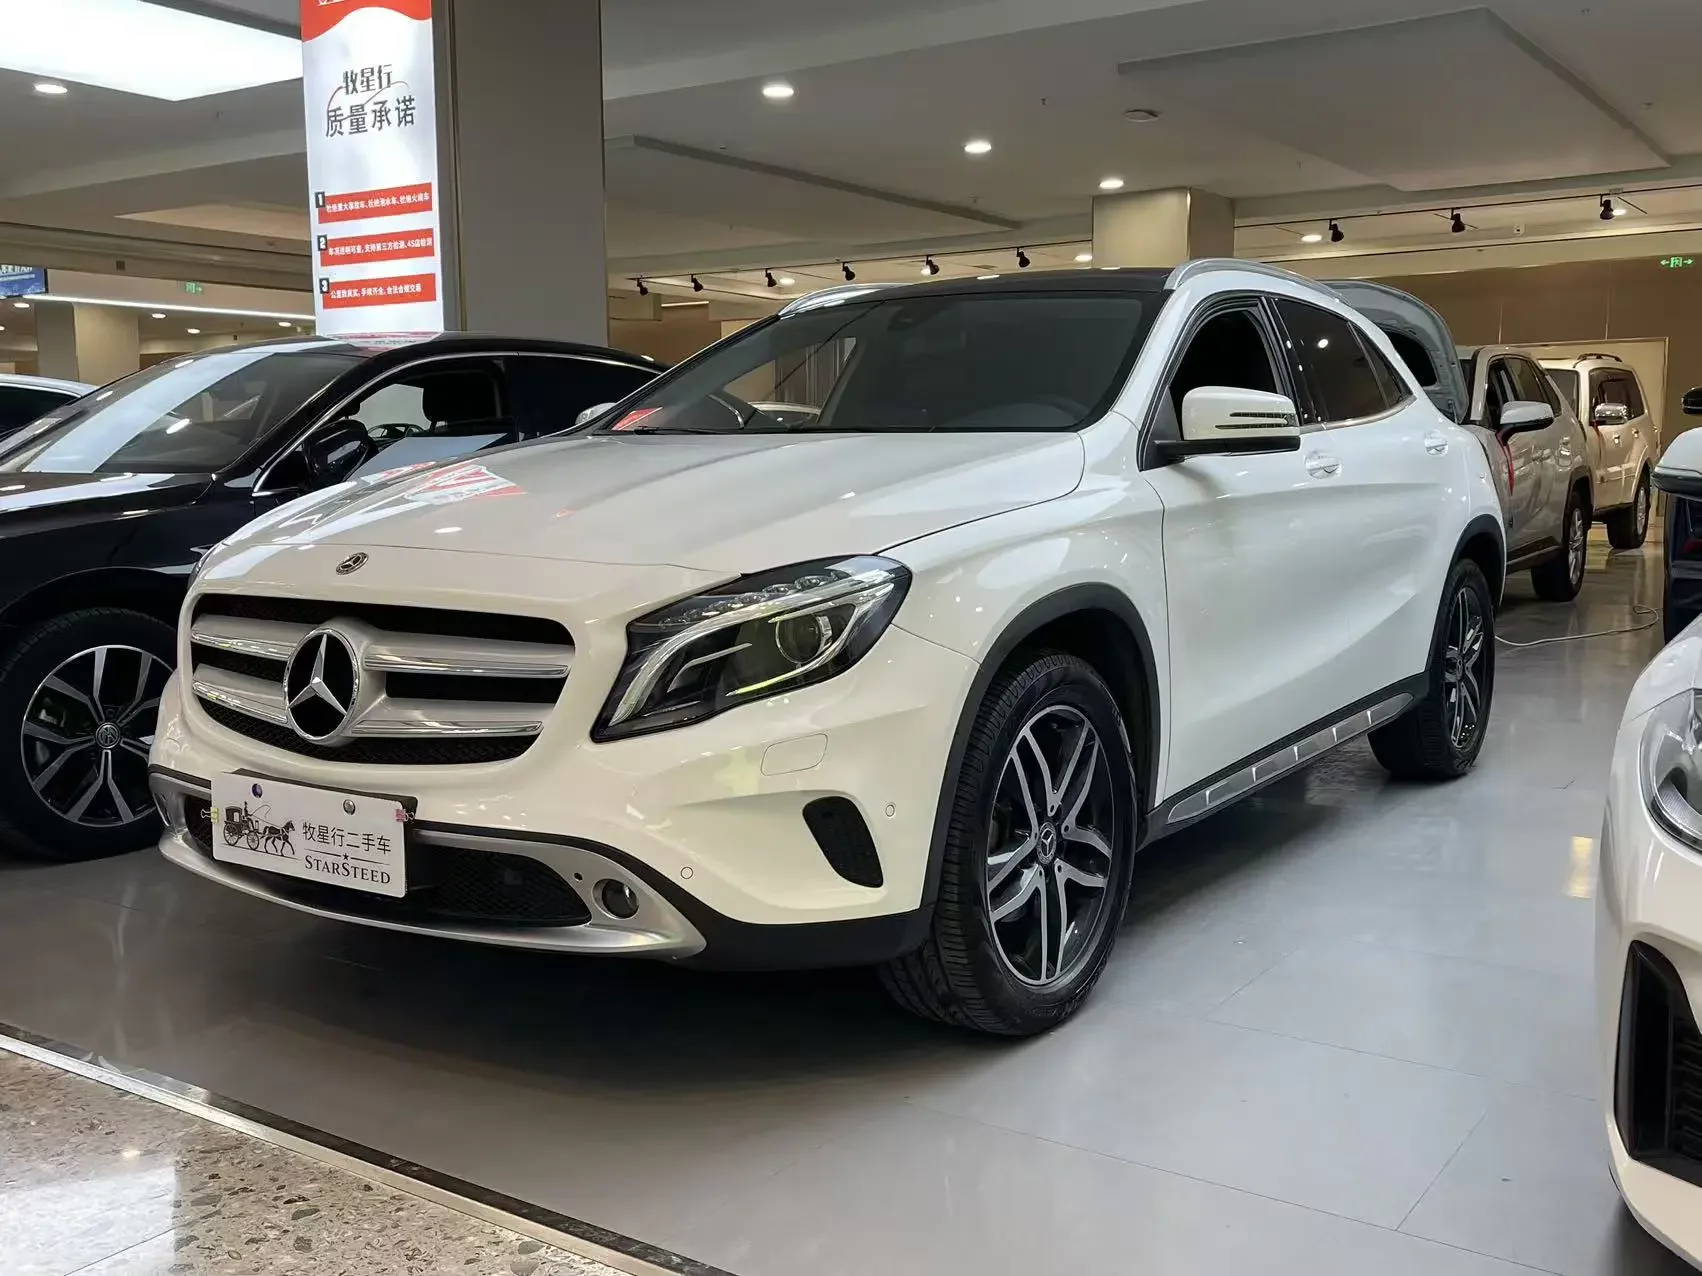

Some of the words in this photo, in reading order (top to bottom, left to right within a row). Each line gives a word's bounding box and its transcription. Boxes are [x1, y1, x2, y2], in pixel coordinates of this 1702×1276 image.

[343, 64, 393, 95] 牧星行
[326, 95, 416, 138] 质量承诺
[317, 193, 324, 206] 1
[319, 237, 326, 249] 2
[321, 280, 328, 293] 3
[302, 822, 392, 854] 牧星行二手车
